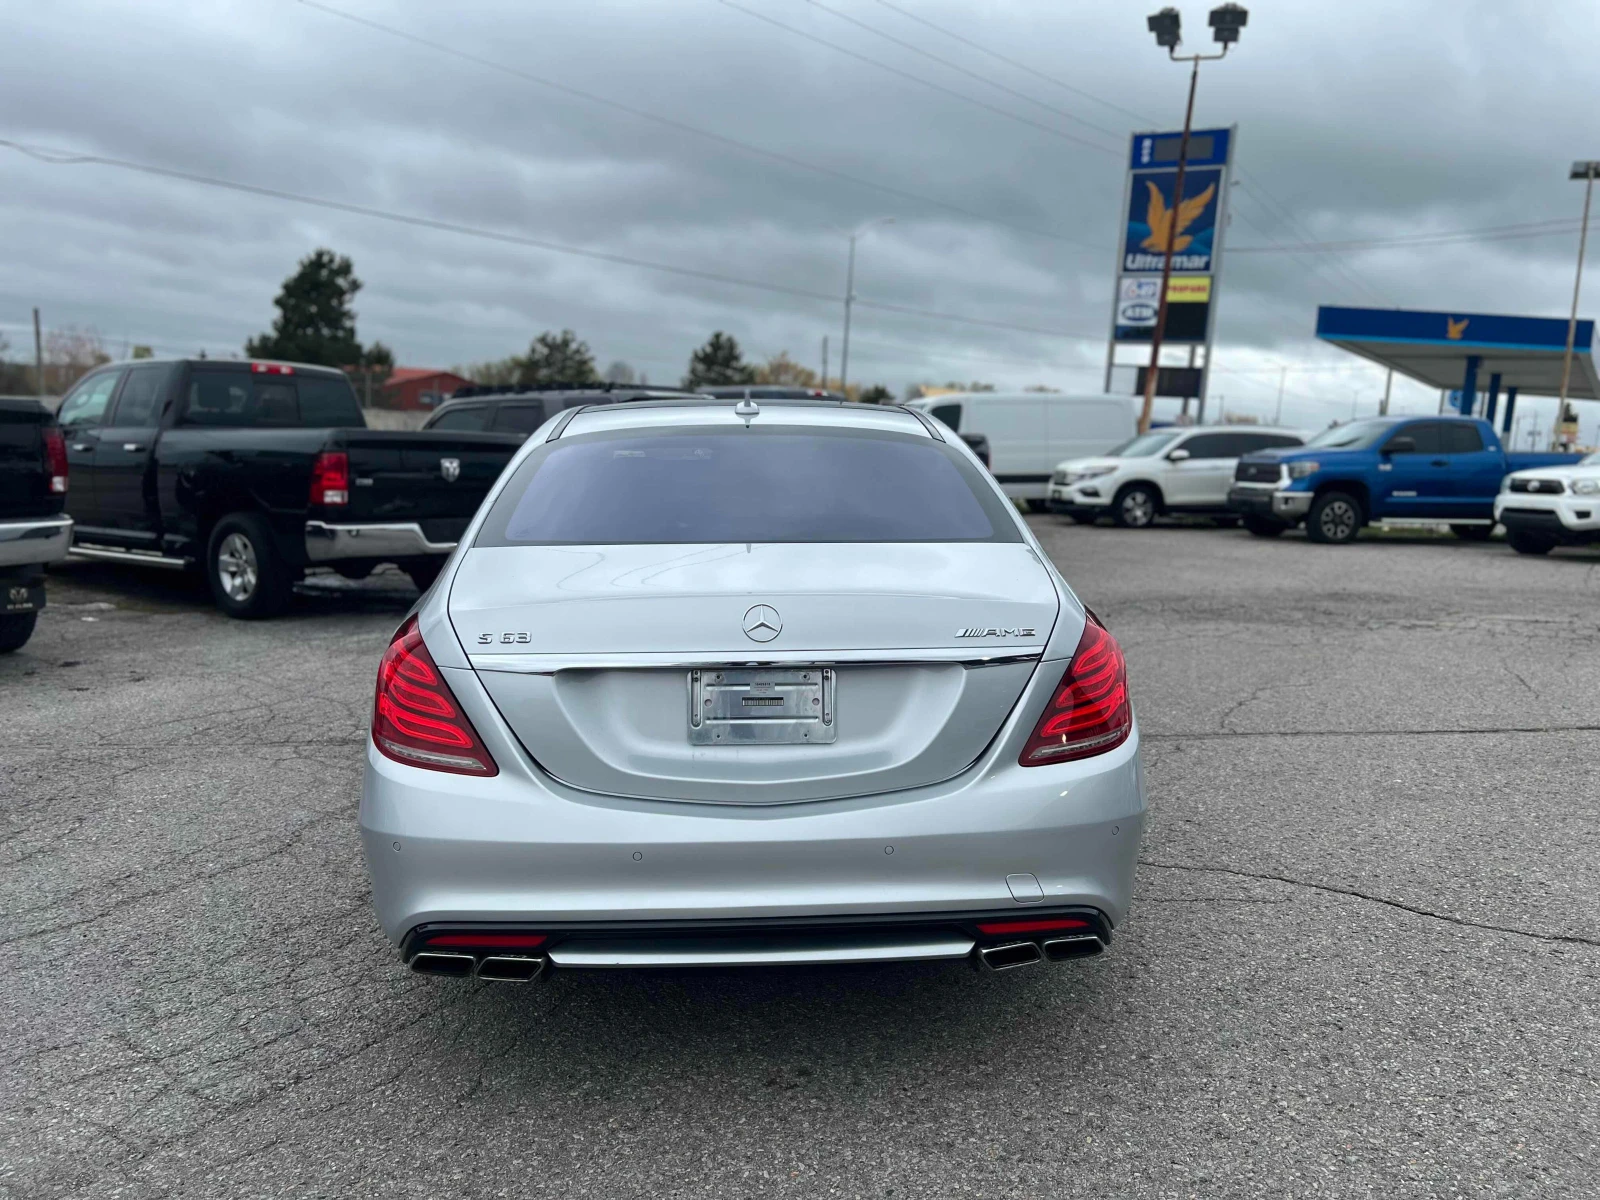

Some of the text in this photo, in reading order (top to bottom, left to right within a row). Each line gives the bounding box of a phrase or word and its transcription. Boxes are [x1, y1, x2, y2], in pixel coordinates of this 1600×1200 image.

[1125, 253, 1210, 270] Ultramar
[477, 631, 532, 645] S 63
